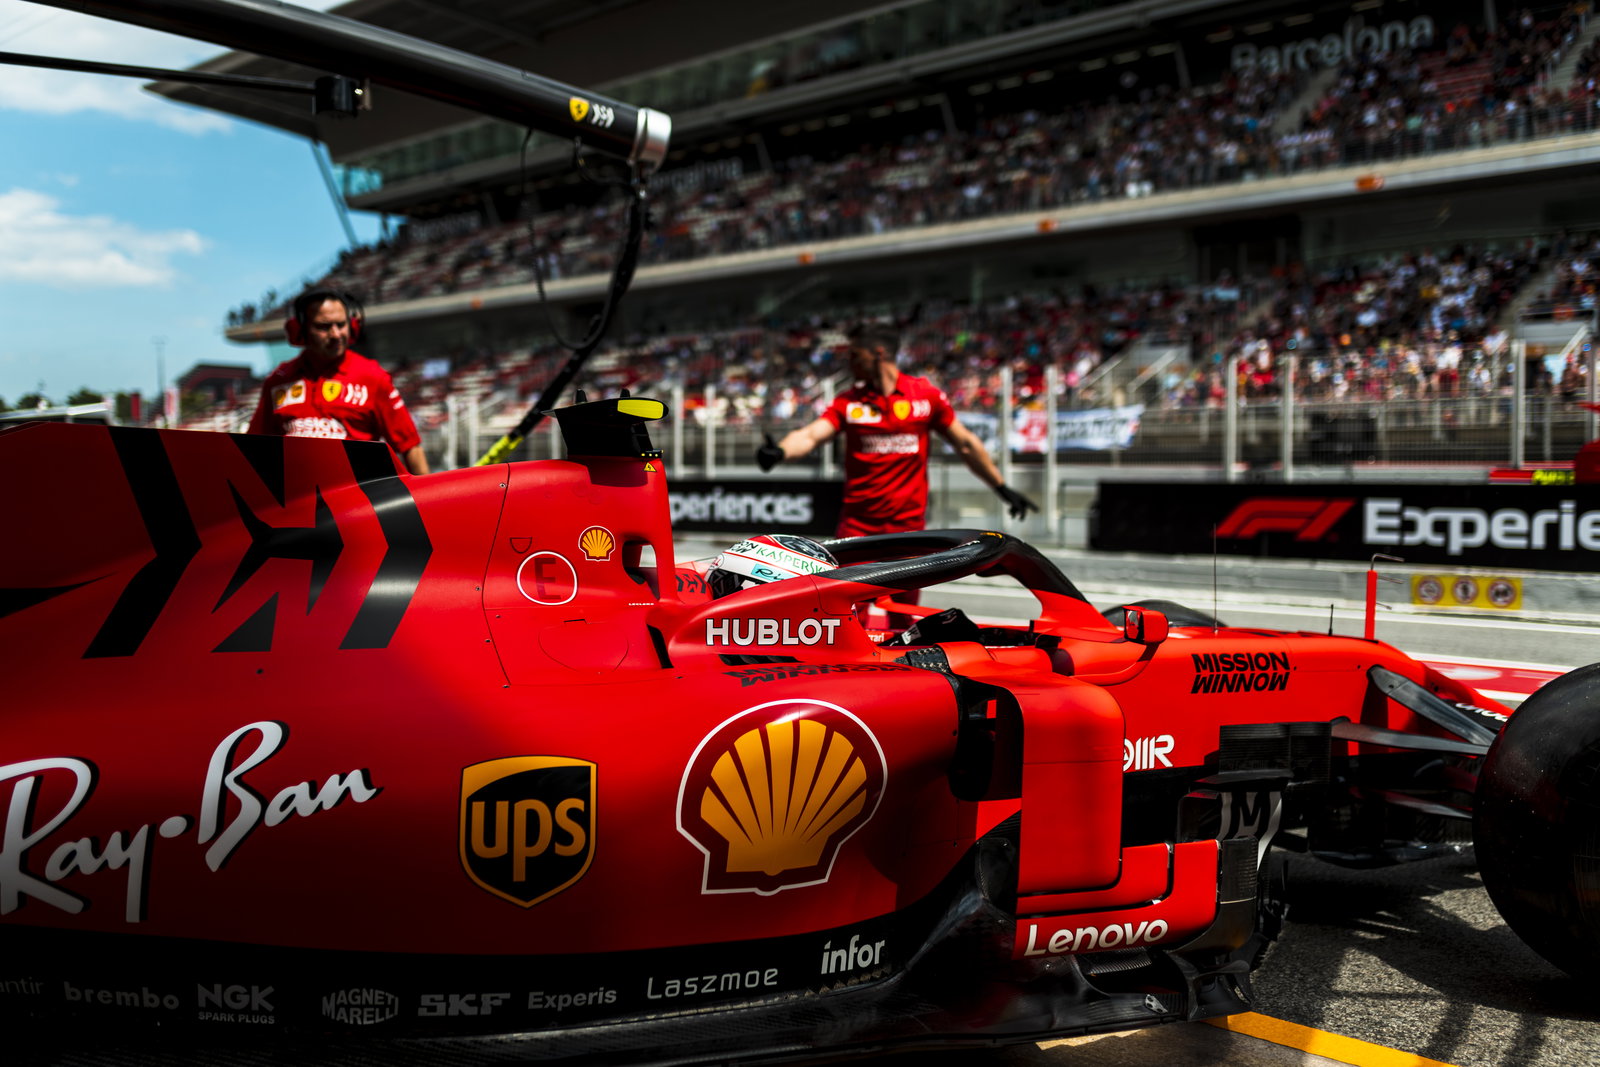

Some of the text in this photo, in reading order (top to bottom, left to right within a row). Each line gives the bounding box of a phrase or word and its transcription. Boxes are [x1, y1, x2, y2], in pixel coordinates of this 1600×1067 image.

[706, 618, 841, 646] HUBLOT
[1190, 652, 1291, 673] MISSION
[1190, 672, 1290, 694] WINNOW
[1023, 919, 1169, 957] Lenovo
[821, 934, 886, 975] infor
[64, 981, 180, 1010] brembo
[197, 983, 275, 1012] NGK
[647, 968, 778, 999] Laszmoe
[418, 993, 511, 1016] SKF
[528, 988, 617, 1011] Experis
[198, 1011, 275, 1025] SPARK PLUGS
